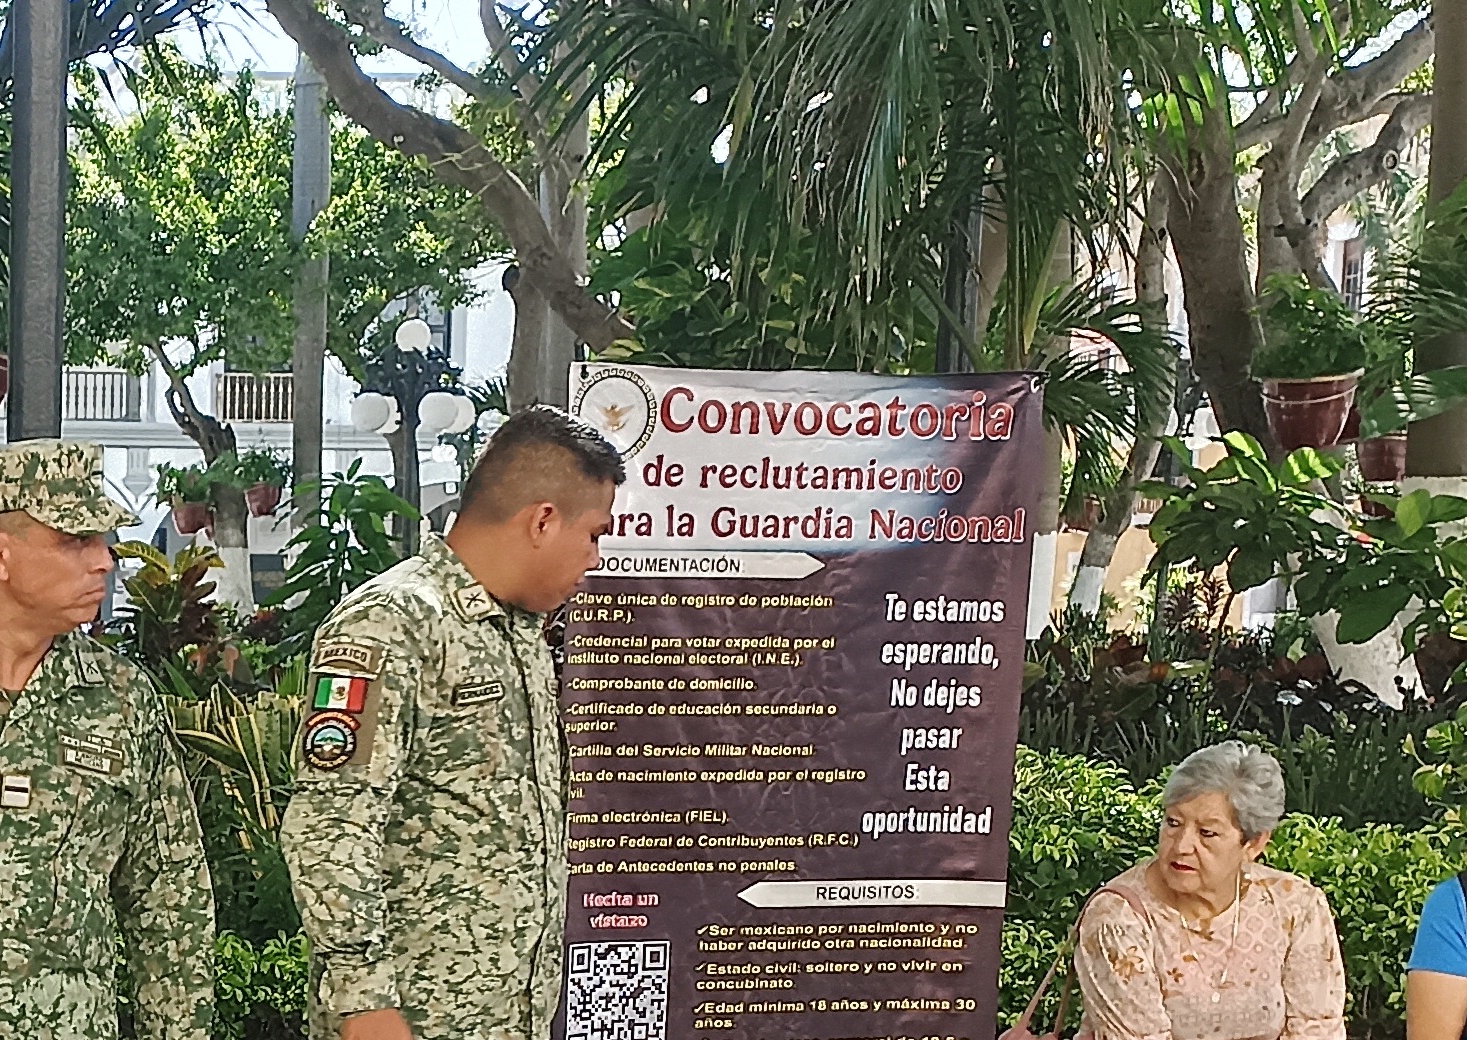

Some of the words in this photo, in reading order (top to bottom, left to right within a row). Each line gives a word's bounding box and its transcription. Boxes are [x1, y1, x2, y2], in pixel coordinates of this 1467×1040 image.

[660, 386, 1016, 441] Convocatoria
[642, 454, 685, 488] de
[698, 457, 965, 494] reclutamiento
[605, 511, 653, 538] ra
[665, 504, 695, 538] la
[710, 505, 854, 539] Guardia
[869, 507, 1028, 544] Nacional
[885, 593, 907, 621] Te
[913, 596, 1005, 622] estamos
[324, 643, 368, 664] MEXICO
[567, 653, 620, 666] instituto
[623, 653, 684, 665] nacional
[688, 653, 749, 665] electoral
[881, 637, 999, 671] esperando,
[667, 678, 685, 690] de
[689, 678, 757, 691] domicilio.
[890, 678, 918, 706] No
[923, 678, 981, 714] dejes
[615, 744, 638, 756] del
[643, 745, 701, 757] Servicio
[705, 744, 747, 756] Militar
[900, 728, 963, 755] pasar
[905, 763, 950, 791] Esta
[602, 809, 681, 823] electrónica
[685, 811, 729, 825] (FIEL).
[862, 806, 992, 839] oportunidad
[637, 894, 659, 906] un
[816, 885, 920, 900] REQUISITOS:
[590, 913, 648, 928] vistazo
[707, 962, 761, 975] Estado
[765, 962, 802, 975] civil:
[806, 961, 860, 973] soltero
[864, 962, 872, 975] y
[878, 961, 897, 972] no
[901, 960, 937, 971] vivir
[941, 961, 963, 972] en
